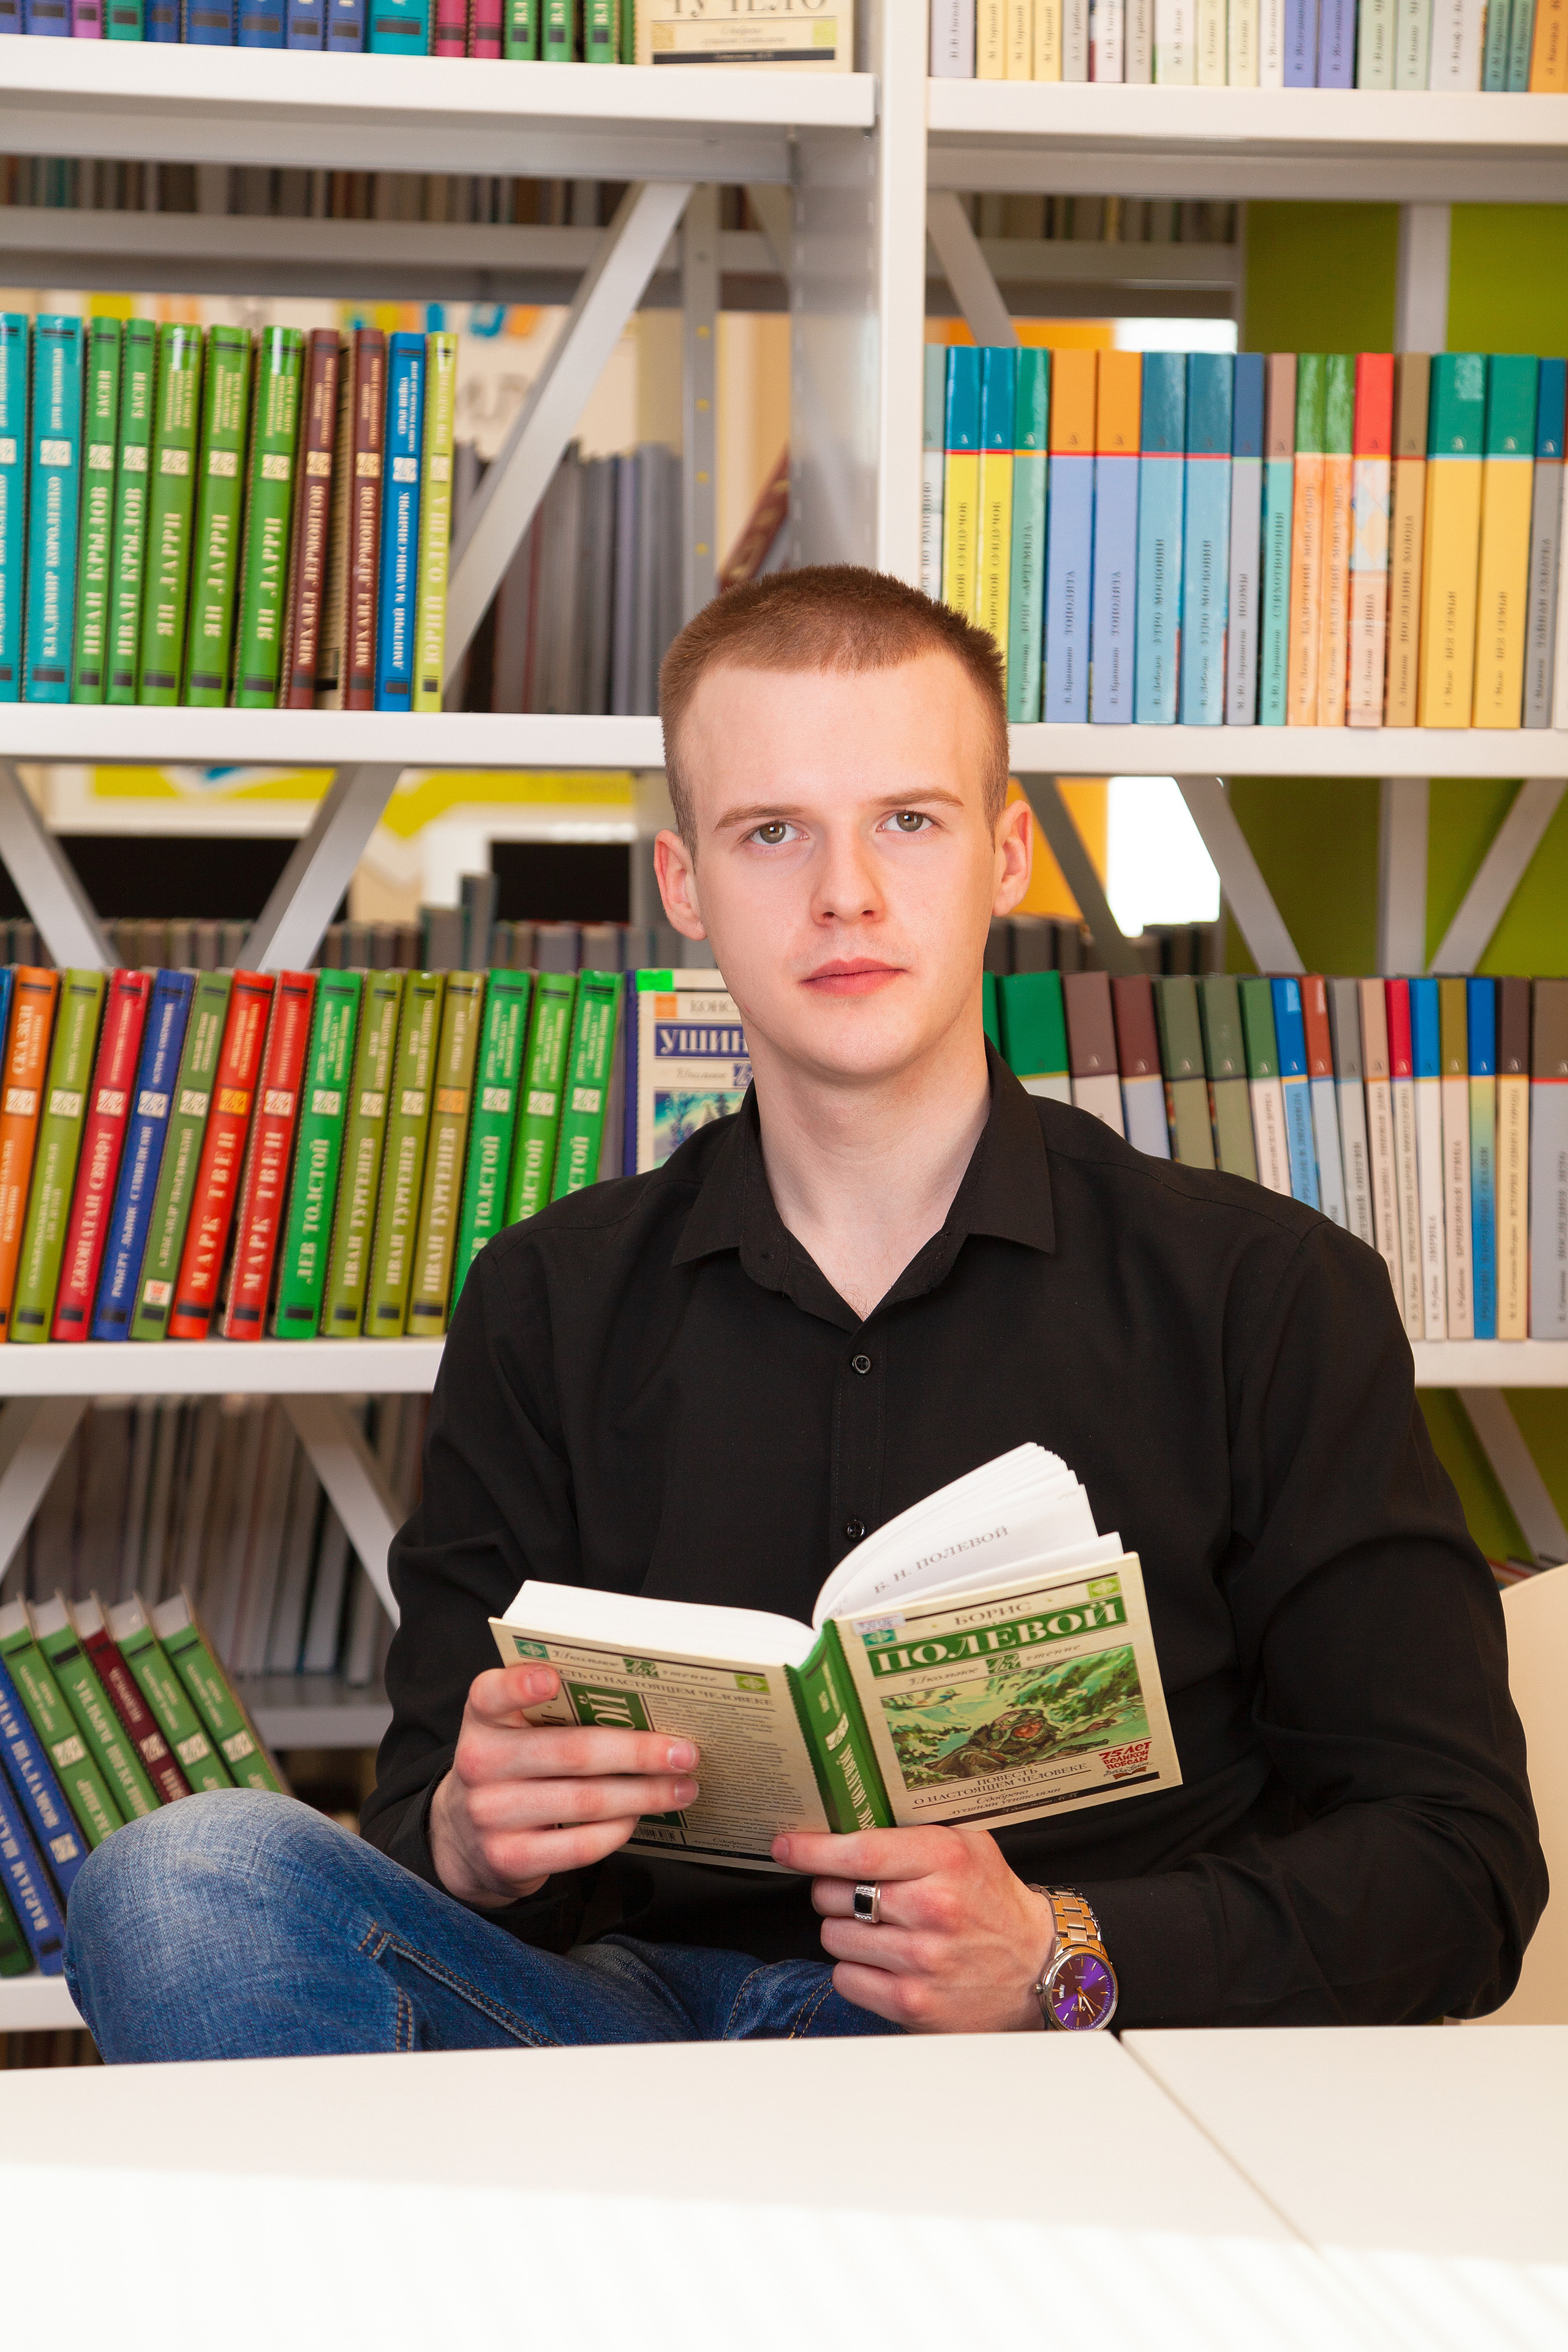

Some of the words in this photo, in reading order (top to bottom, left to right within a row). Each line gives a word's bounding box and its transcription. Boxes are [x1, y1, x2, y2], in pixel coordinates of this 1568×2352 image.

[96, 370, 111, 417] БАСНИ
[130, 372, 146, 418] БАСНИ
[45, 476, 62, 567] КОРОЛЕНКО
[87, 486, 107, 581] КРЫЛОВ
[121, 488, 142, 581] КРЫЛОВ
[160, 513, 182, 592] ЛАРРИ
[207, 514, 230, 594] ЛАРРИ
[304, 485, 326, 585] ЛЕРМОНТОВ
[358, 486, 376, 587] ЛЕРМОНТОВ
[428, 496, 447, 582] ОЛЕША
[991, 501, 1001, 567] СУНДУЧОК
[260, 517, 282, 597] ЛАРРИ
[43, 571, 59, 657] ВЛАДИМИР
[83, 592, 102, 654] ИВАН
[117, 593, 137, 655] ИВАН
[157, 604, 176, 636] ЯН
[204, 605, 222, 637] ЯН
[257, 609, 276, 640] ЯН
[956, 573, 967, 612] РСКОЙ
[989, 573, 1000, 630] МОРСКОЙ
[298, 591, 318, 666] МИХАИЛ
[355, 593, 374, 668] МИХАИЛ
[391, 608, 405, 669] ДМИТРИЙ
[424, 595, 443, 664] ЮРИЙ
[256, 1131, 284, 1200] ТВЕН
[302, 1139, 330, 1234] ТОЛСТОЙ
[350, 1137, 375, 1229] ТУРГЕНЕВ
[392, 1136, 417, 1226] ТУРГЕНЕВ
[431, 1128, 456, 1226] ТУРГЕНЕВ
[474, 1136, 500, 1229] ТОЛСТОЙ
[519, 1139, 545, 1217] ОЛСТОЙ
[567, 1136, 590, 1192] СТОЙ
[190, 1216, 220, 1287] МАРК
[207, 1131, 236, 1200] ТВЕН
[243, 1216, 271, 1289] МАРК
[297, 1242, 317, 1284] ЛЕВ
[343, 1235, 363, 1287] ИВАН
[386, 1234, 405, 1285] ИВАН
[423, 1235, 445, 1292] ИВАН
[894, 1569, 912, 1583] Н.
[916, 1526, 1009, 1570] ПОЛЕВОЙ
[876, 1600, 1120, 1673] ПОЛЕВОЙ
[954, 1601, 1032, 1627] БОРИС
[604, 1676, 696, 1697] НАСТОЯЩЕМ
[699, 1691, 773, 1706] ЧЕЛОВЕКЕ
[908, 1667, 979, 1686] Школьное
[1025, 1644, 1081, 1662] чтение
[105, 1744, 150, 1817] ШЕКСПИ
[835, 1744, 867, 1809] ПОЛЕВОЙ
[927, 1781, 1014, 1803] НАСТОЯЩЕМ
[1017, 1763, 1088, 1783] ЧЕЛОВЕКЕ
[976, 1768, 1038, 1786] ПОВЕСТЬ
[1098, 1747, 1125, 1760] 75
[976, 1789, 1029, 1804] Одобрено
